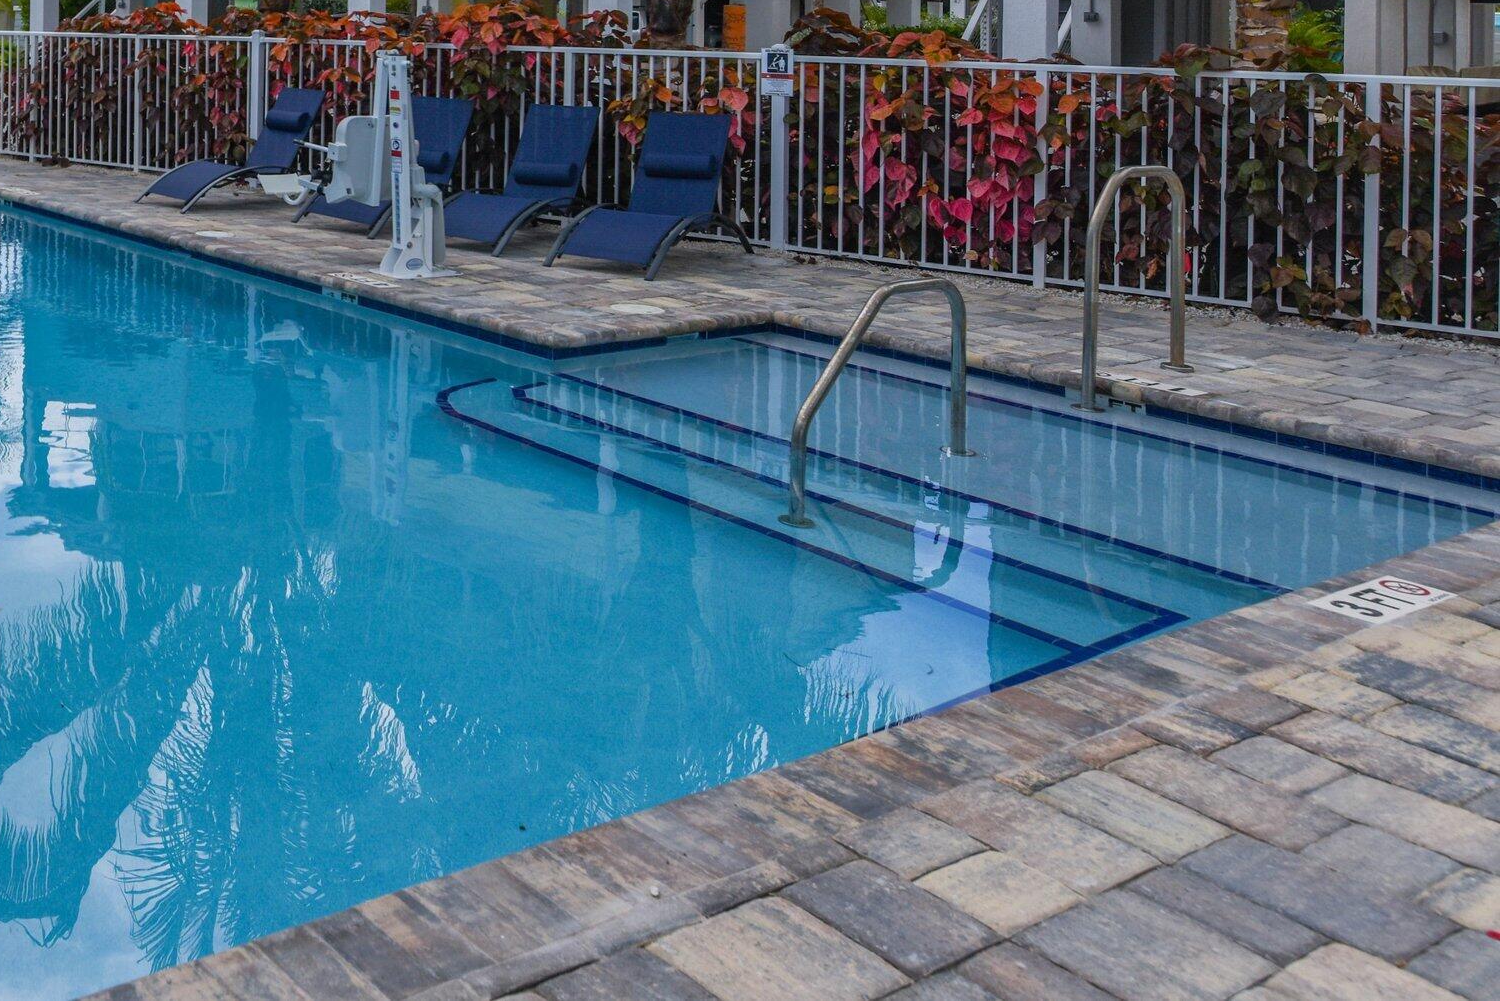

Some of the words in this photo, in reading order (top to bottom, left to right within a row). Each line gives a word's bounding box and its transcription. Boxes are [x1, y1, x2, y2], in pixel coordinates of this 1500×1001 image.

[1108, 398, 1142, 413] FT
[1348, 587, 1416, 610] FT
[1330, 599, 1384, 617] 3
